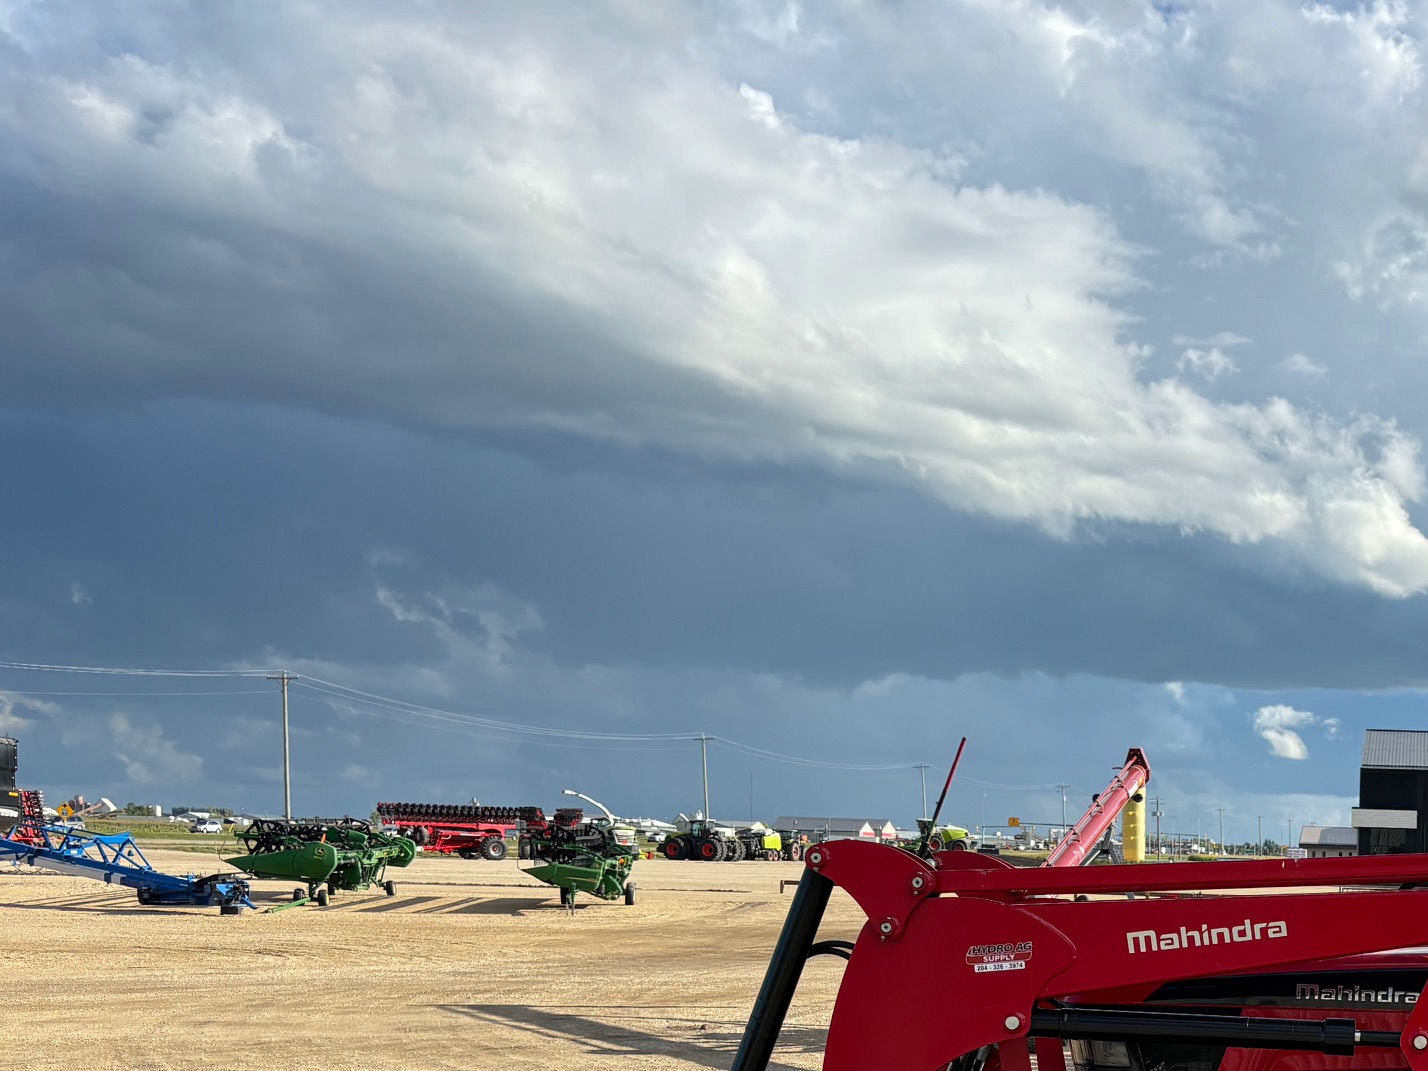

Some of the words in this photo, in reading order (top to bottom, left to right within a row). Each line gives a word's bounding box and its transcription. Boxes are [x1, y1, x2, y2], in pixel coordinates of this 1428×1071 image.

[1126, 918, 1288, 954] Mahindra
[970, 943, 1014, 956] HYDRO
[1016, 941, 1033, 952] AG
[983, 954, 1015, 963] SUPPLY
[1296, 983, 1420, 1004] Mahindra
